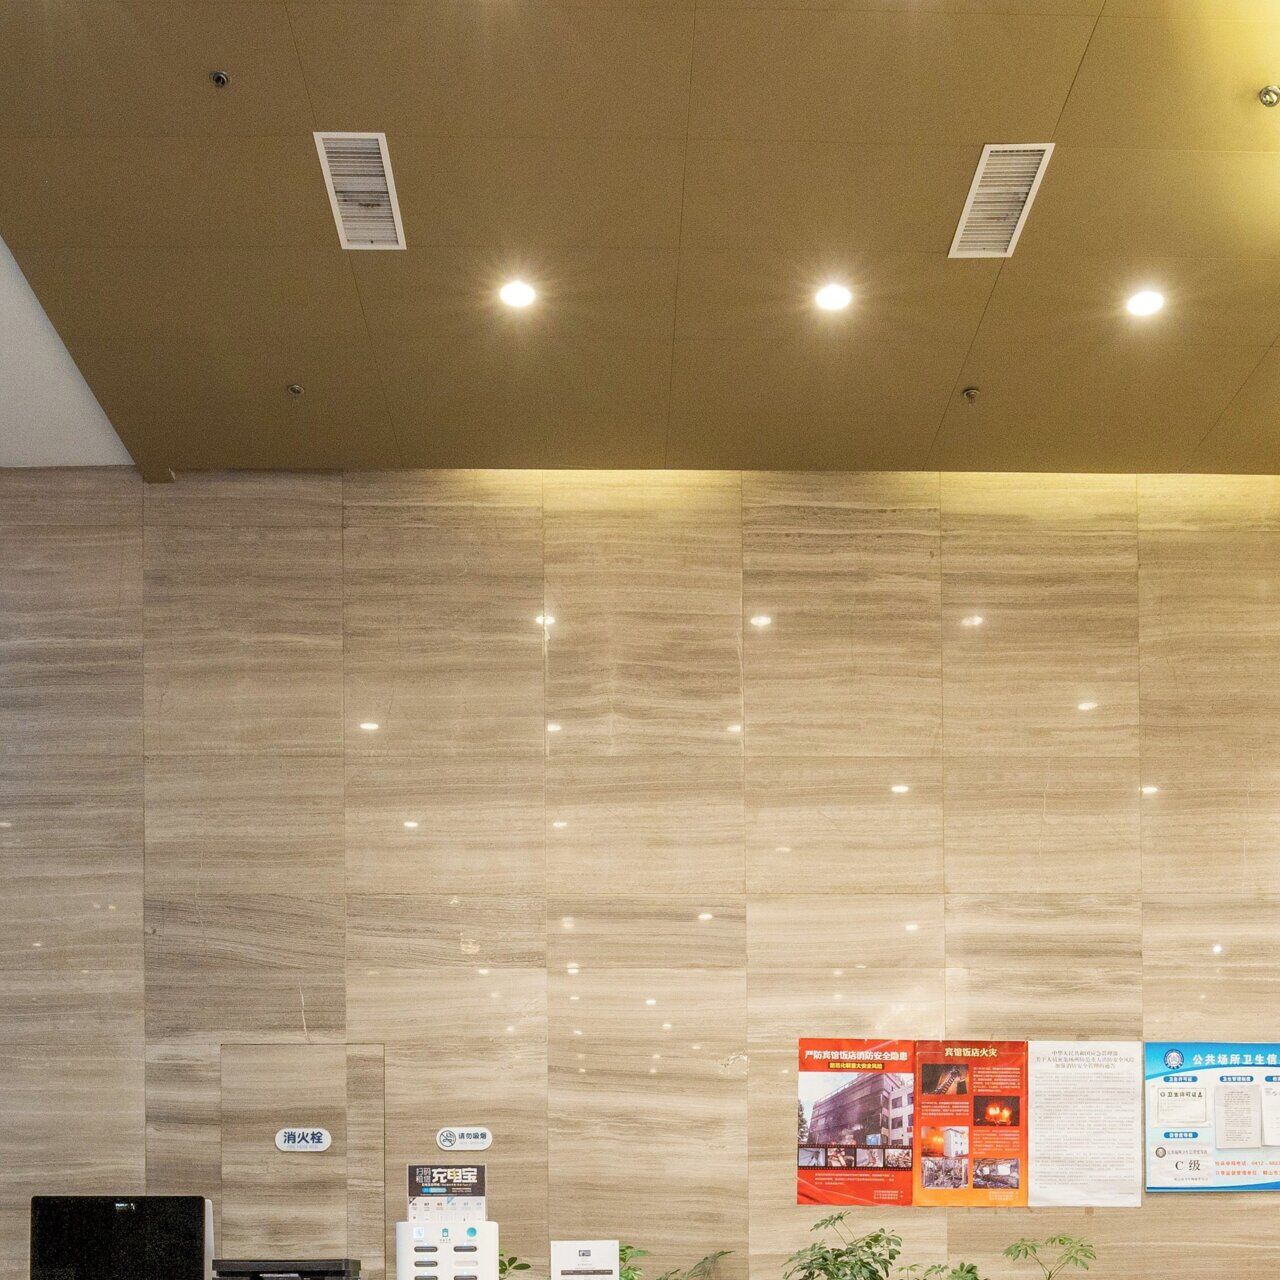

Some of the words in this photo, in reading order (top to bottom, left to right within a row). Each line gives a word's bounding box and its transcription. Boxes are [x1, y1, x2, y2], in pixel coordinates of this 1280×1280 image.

[804, 1050, 908, 1061] 严防宾馆饭店消防安全隐患
[945, 1047, 998, 1057] 宾馆饭店火灾
[284, 1131, 323, 1144] 消火栓
[459, 1132, 487, 1140] 请勿吸烟
[1175, 1161, 1184, 1170] C
[1189, 1160, 1201, 1171] 级
[432, 1167, 478, 1183] 充电宝
